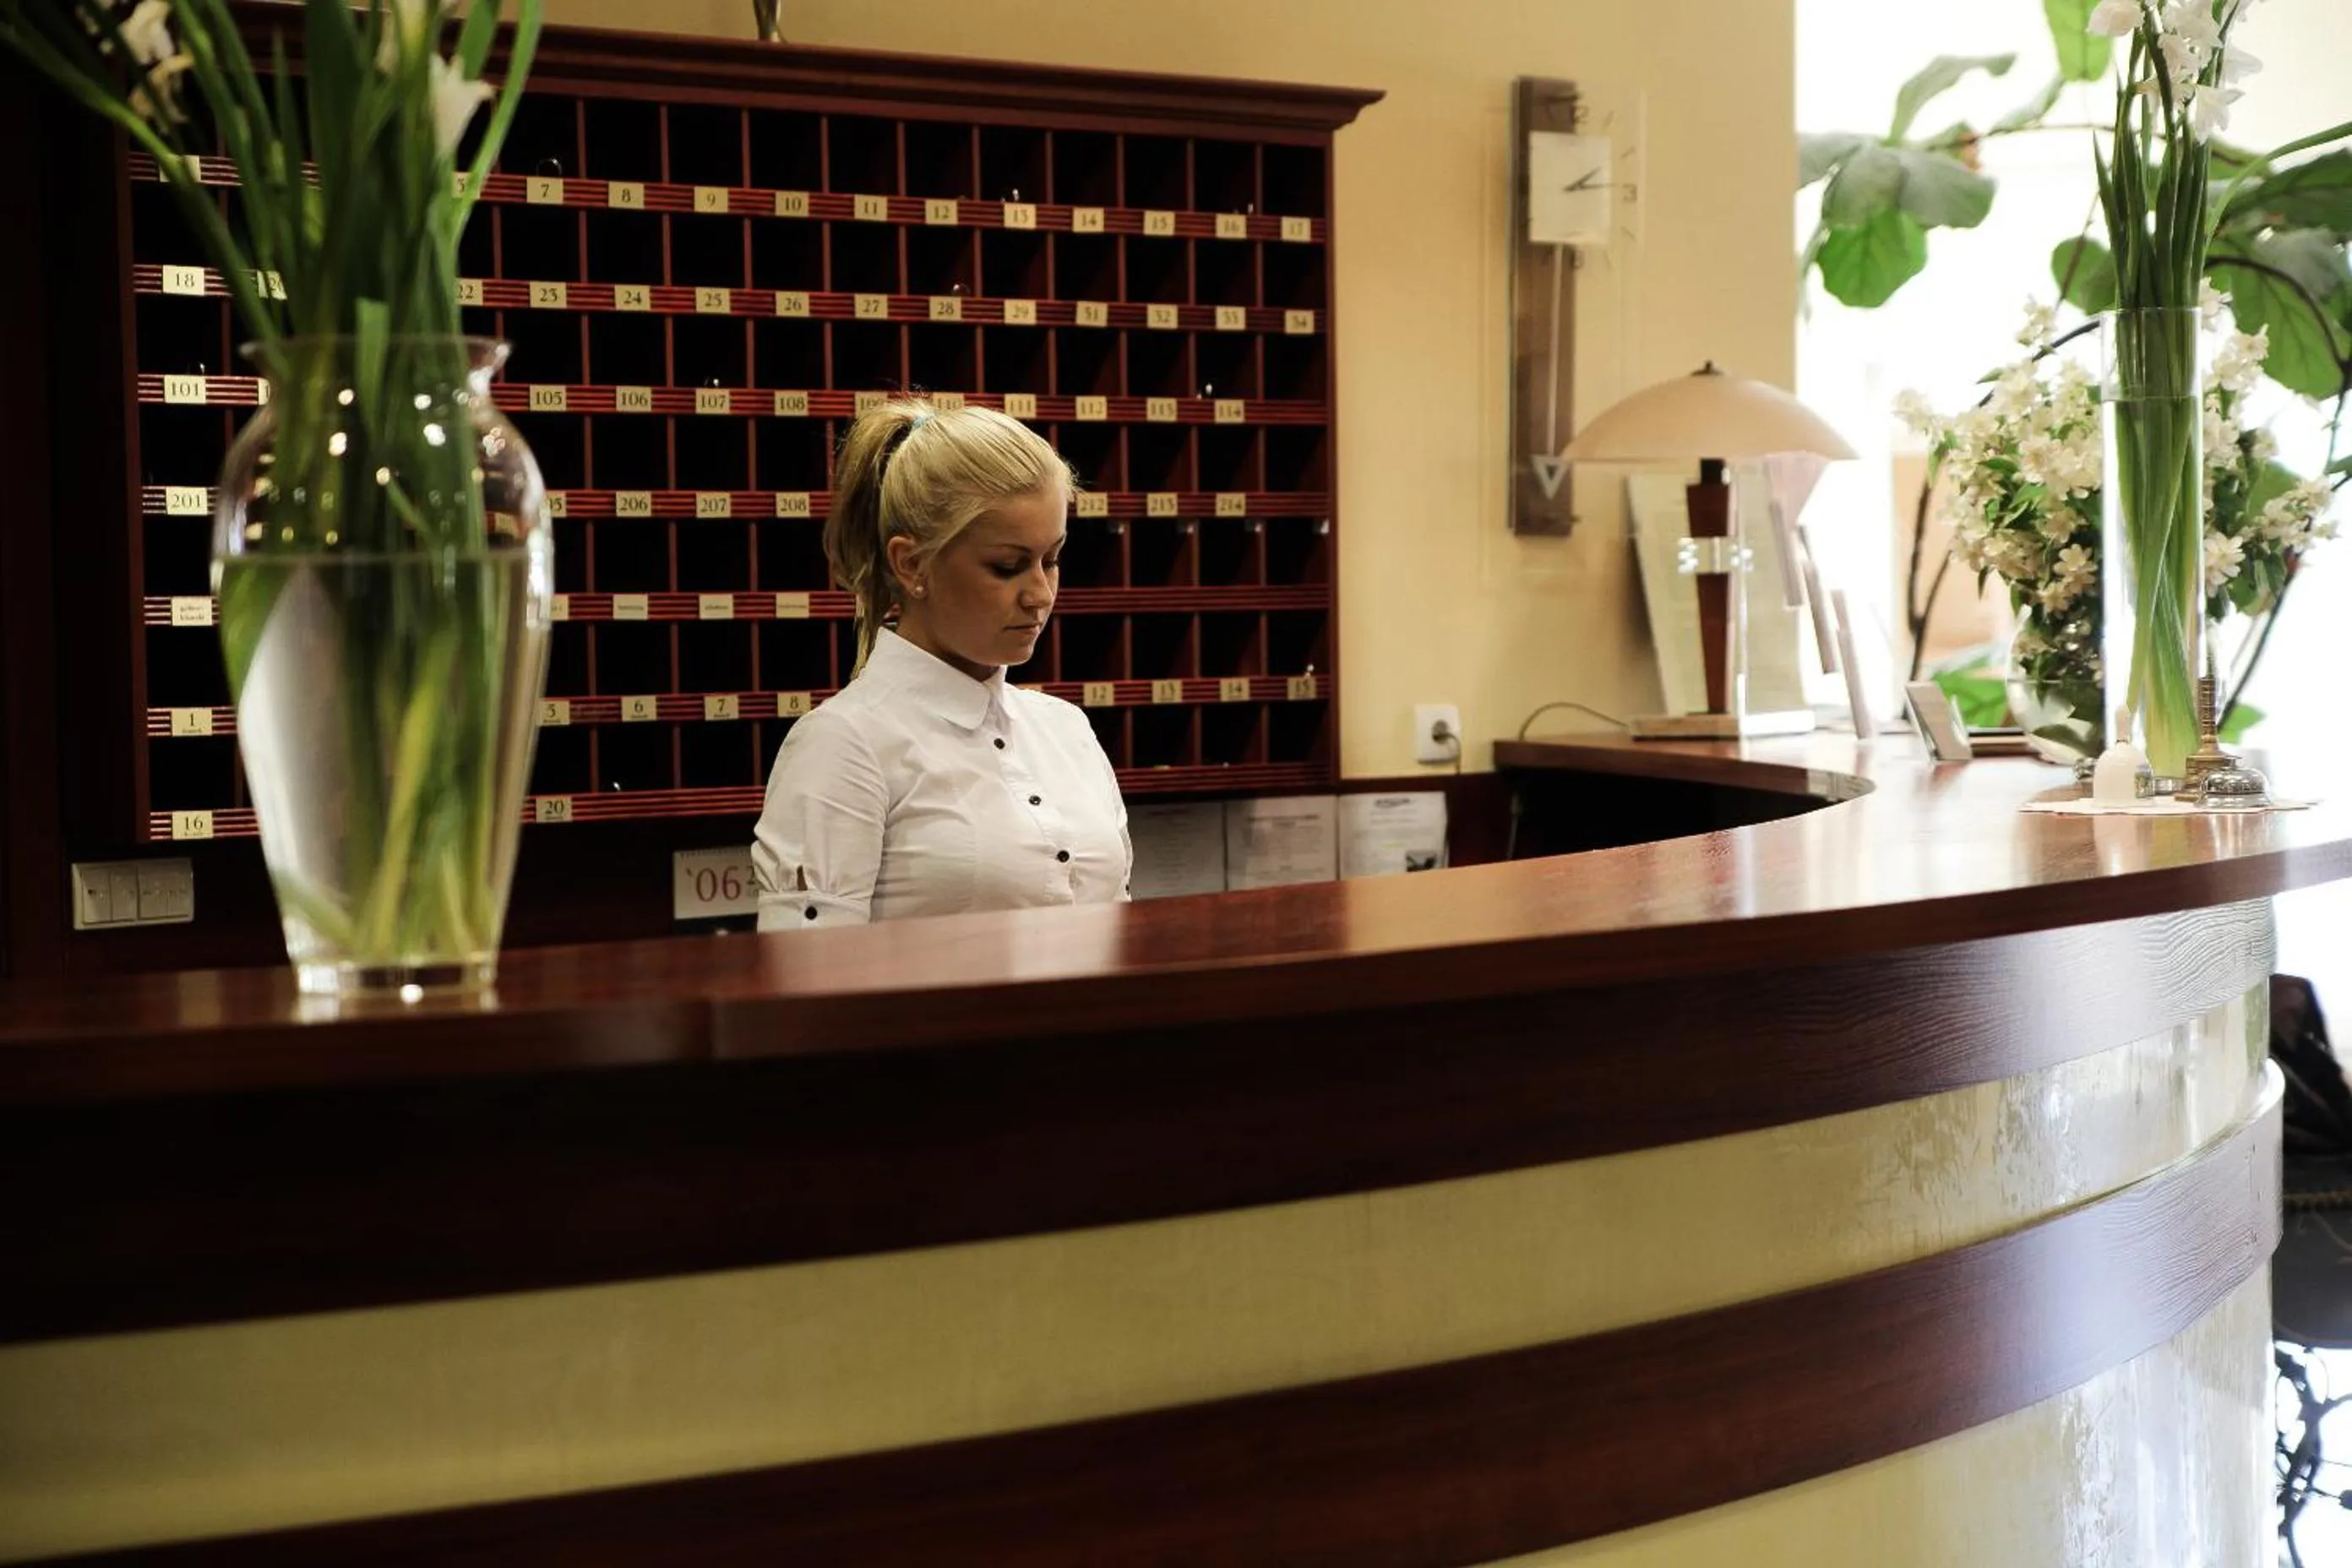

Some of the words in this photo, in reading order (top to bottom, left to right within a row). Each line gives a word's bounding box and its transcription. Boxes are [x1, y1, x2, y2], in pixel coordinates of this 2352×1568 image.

[541, 182, 550, 199] 7
[621, 188, 632, 204] 8
[1622, 183, 1637, 203] 3
[706, 193, 716, 207] 9
[785, 197, 803, 211] 10
[863, 201, 878, 215] 11
[934, 205, 950, 220] 12
[1081, 214, 1097, 227] 14
[176, 273, 195, 288] 18
[456, 285, 474, 300] 22
[539, 287, 558, 302] 23
[623, 290, 643, 305] 24
[705, 292, 722, 308] 25
[784, 297, 803, 312] 26
[863, 298, 880, 313] 27
[937, 302, 955, 317] 28
[172, 382, 199, 396] 101
[536, 391, 563, 406] 105
[622, 392, 649, 406] 106
[701, 395, 726, 409] 107
[780, 396, 806, 411] 108
[1010, 400, 1032, 413] 111
[172, 493, 201, 509] 201
[619, 497, 649, 512] 206
[700, 497, 727, 514] 207
[780, 498, 808, 512] 208
[1079, 498, 1105, 513] 212
[634, 700, 644, 714] 6
[717, 697, 726, 713] 7
[789, 695, 799, 710] 8
[189, 712, 194, 727] 1
[545, 799, 565, 815] 20
[185, 816, 204, 830] 16
